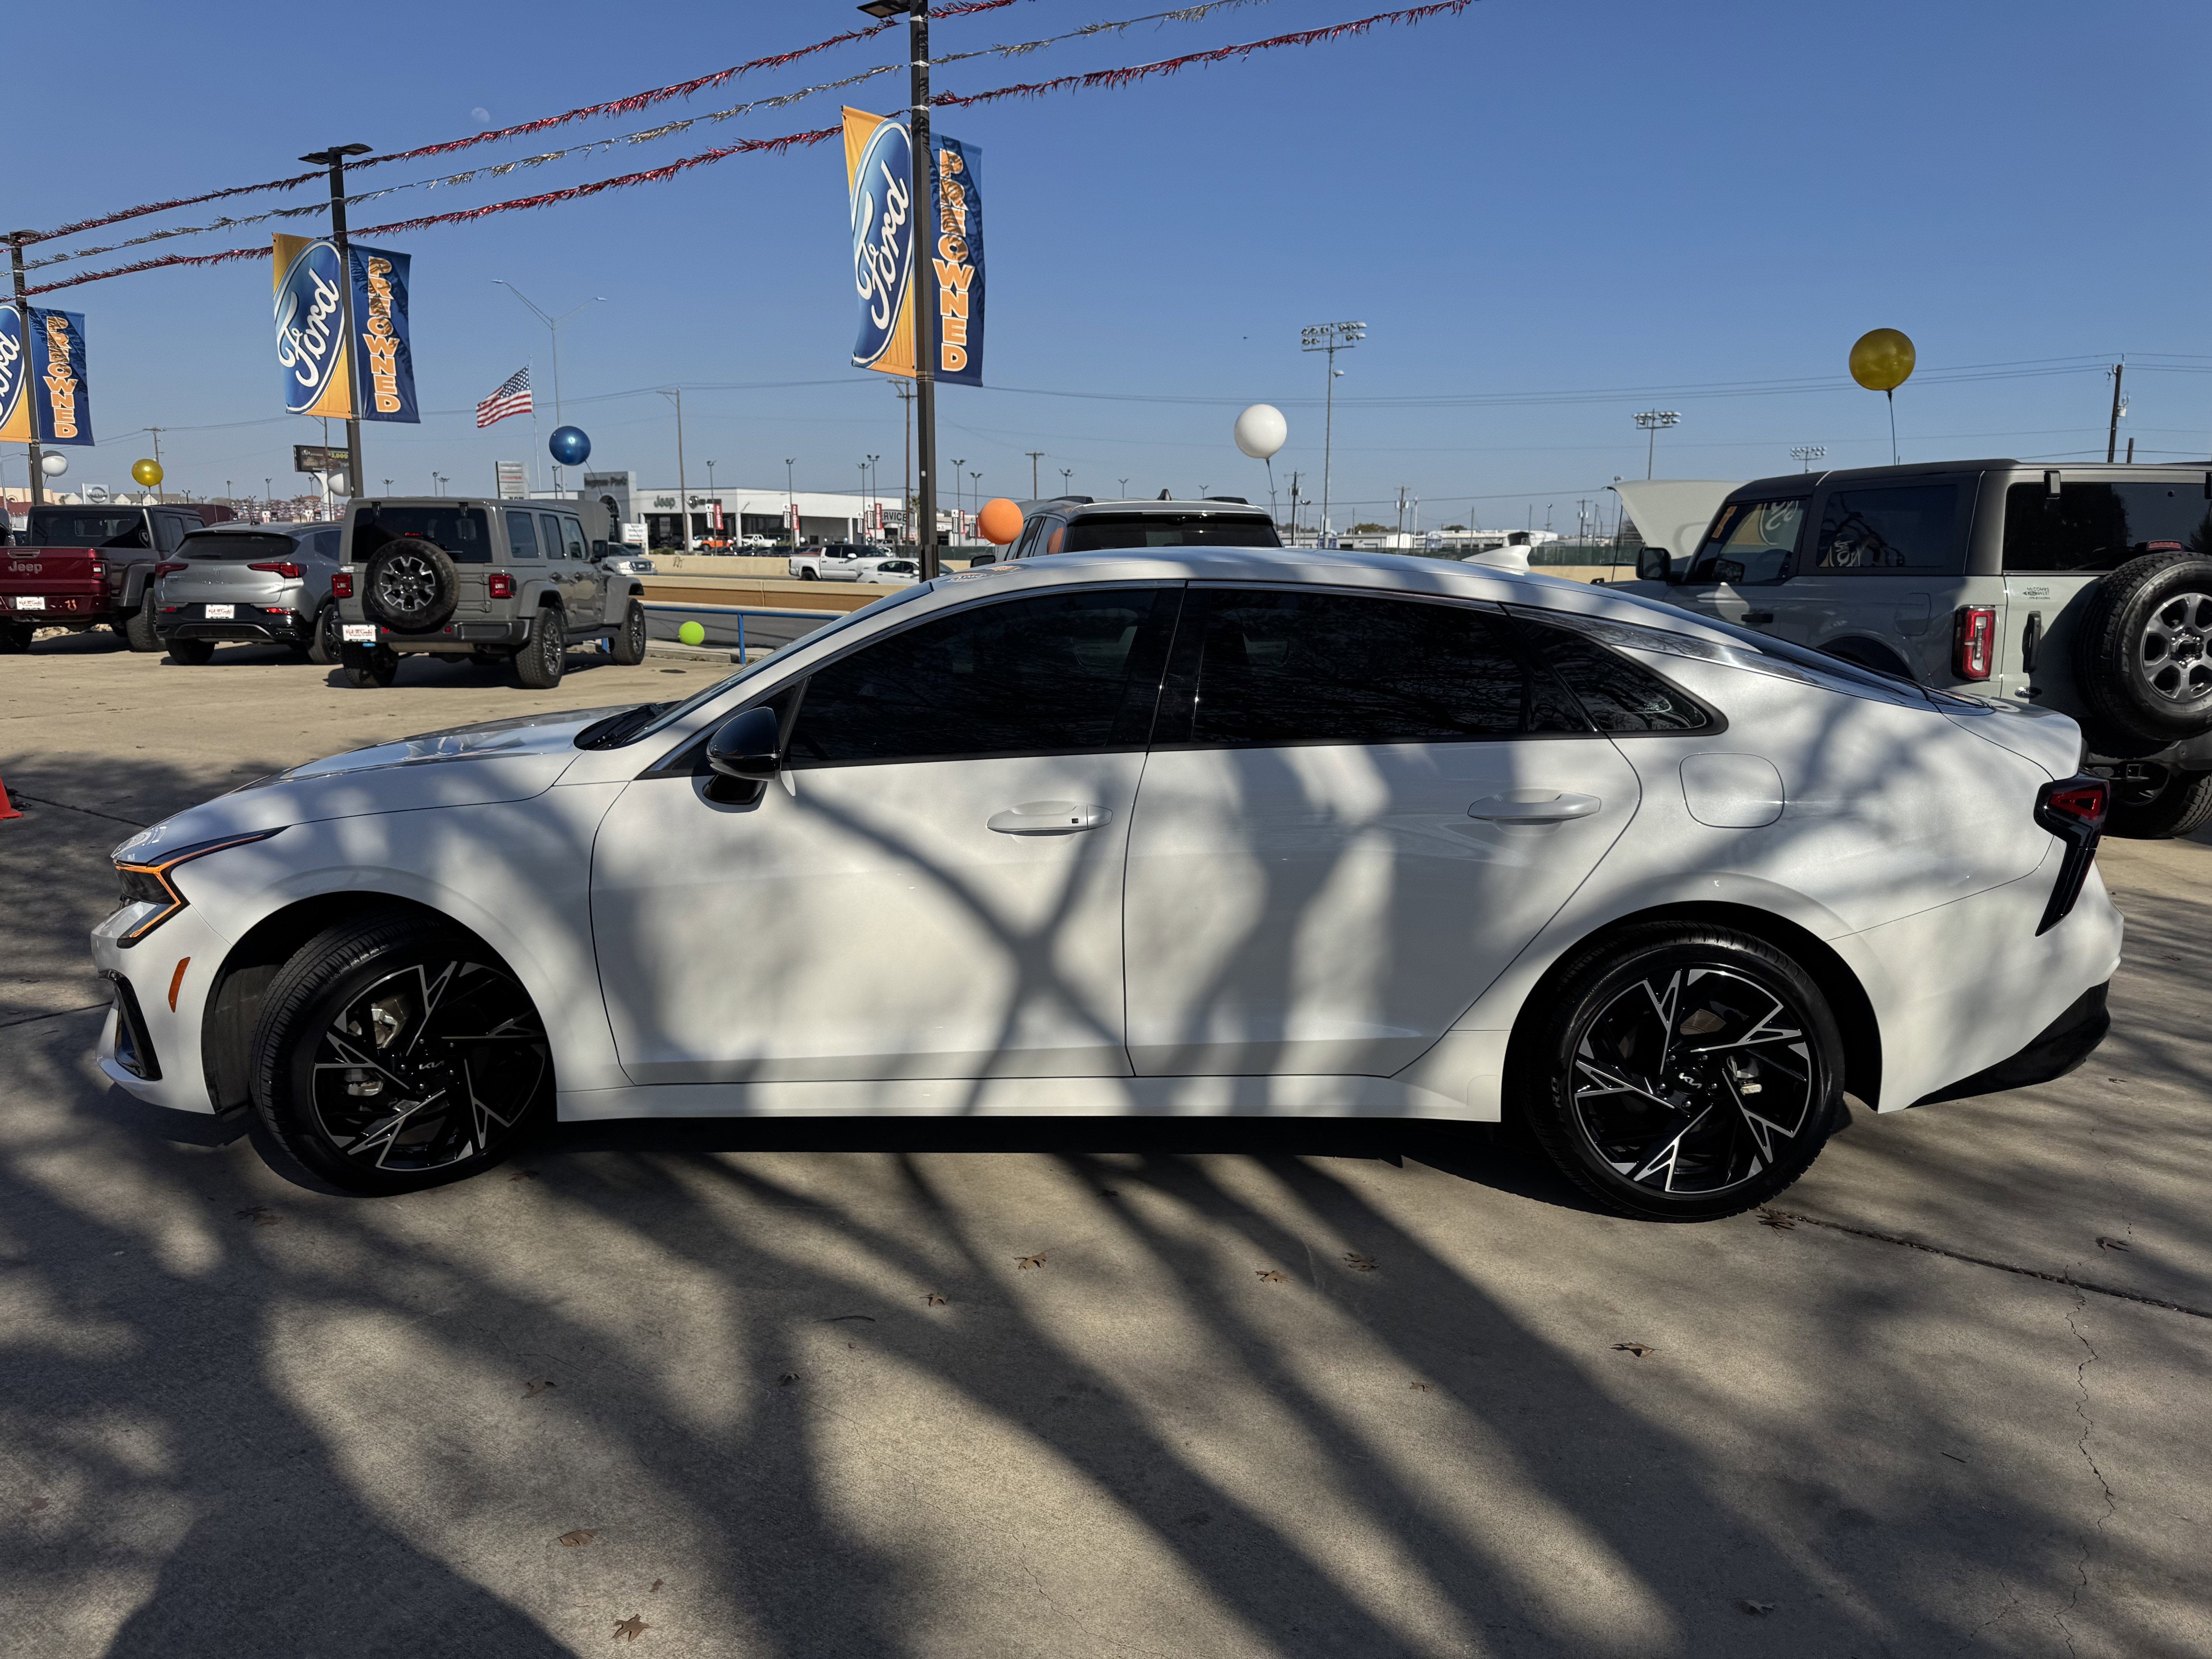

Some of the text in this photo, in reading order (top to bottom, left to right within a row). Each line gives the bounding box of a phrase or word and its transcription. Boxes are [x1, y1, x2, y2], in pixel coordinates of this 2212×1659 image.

[855, 159, 910, 330] Ford
[932, 148, 975, 372] PREOWNED
[43, 316, 79, 438] PREOWNED
[276, 268, 340, 387] Ford
[362, 256, 401, 413] PREOWNED
[8, 561, 43, 574] Jeep
[882, 511, 907, 521] RVICE
